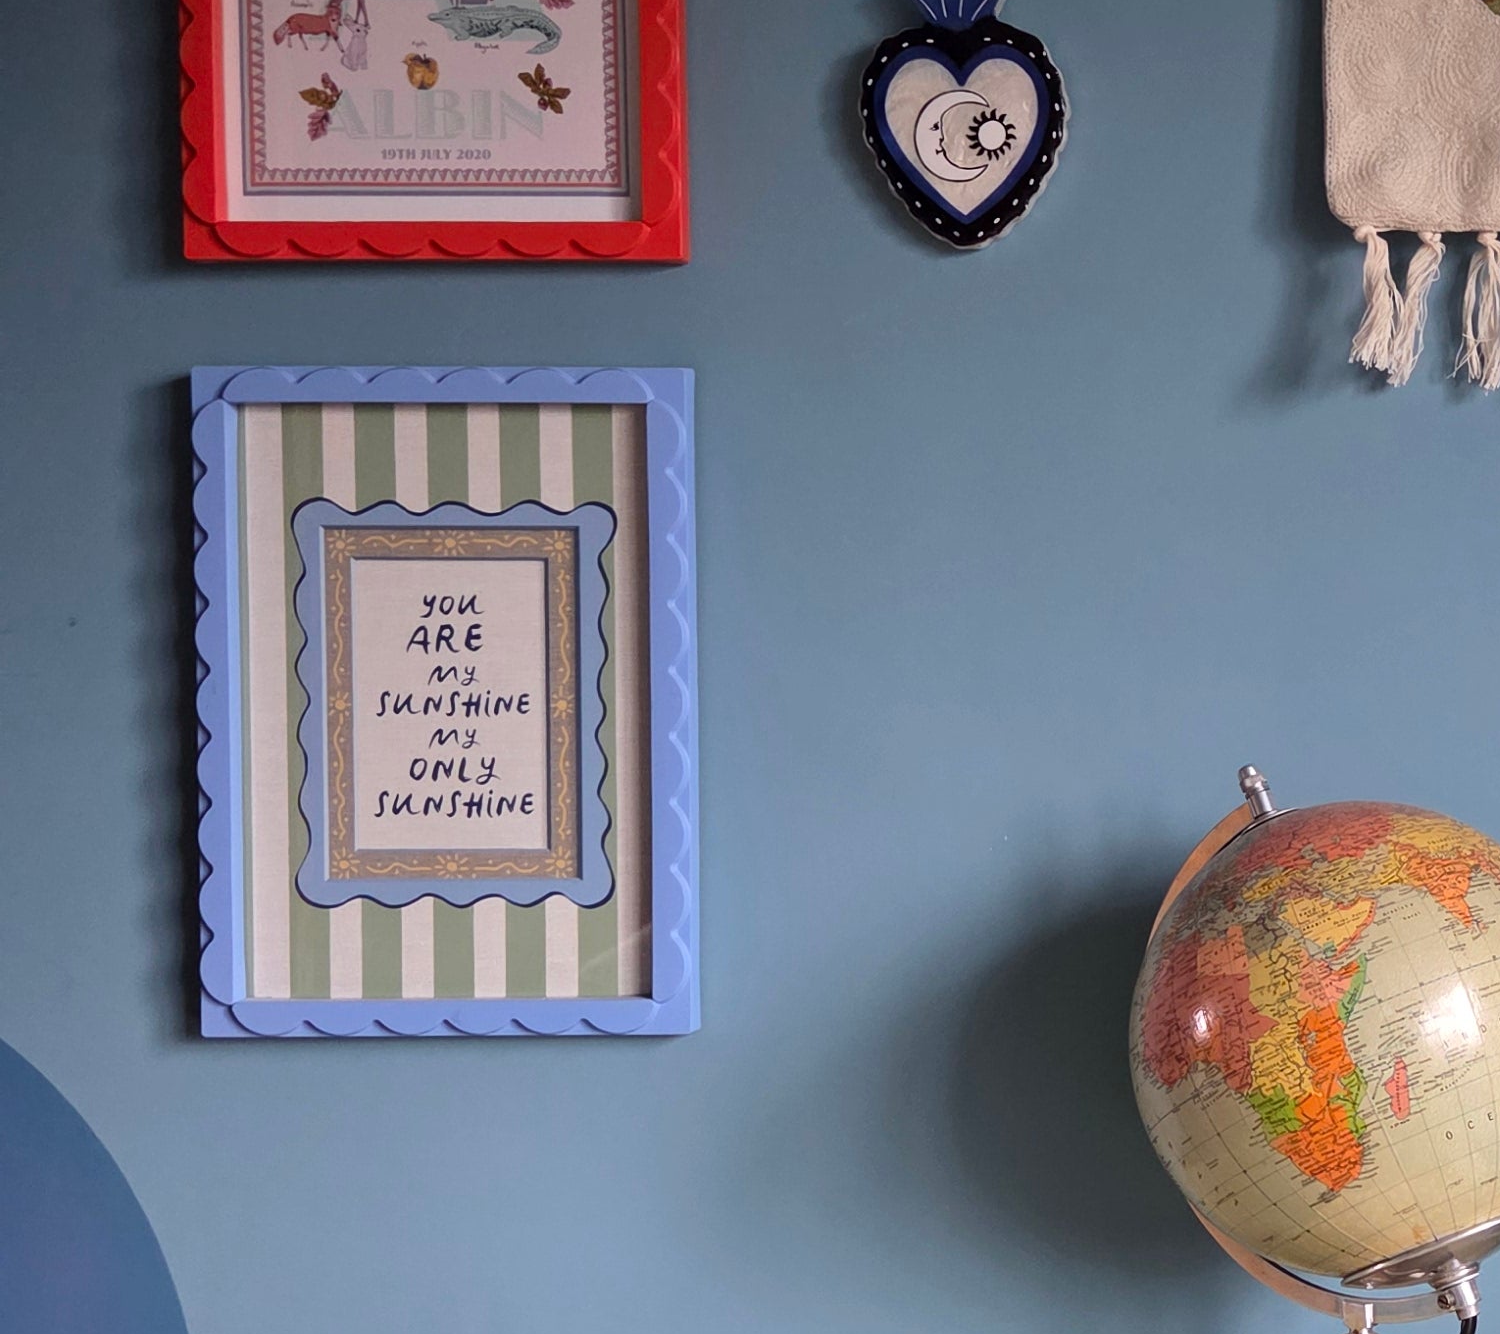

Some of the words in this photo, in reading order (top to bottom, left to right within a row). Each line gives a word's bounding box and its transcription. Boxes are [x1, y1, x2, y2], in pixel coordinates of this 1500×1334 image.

[330, 89, 544, 141] ALBIN
[381, 149, 416, 159] 19TH
[420, 149, 452, 161] JULY
[456, 149, 491, 160] 2020
[406, 625, 485, 654] ARE
[409, 756, 501, 784] ONLY
